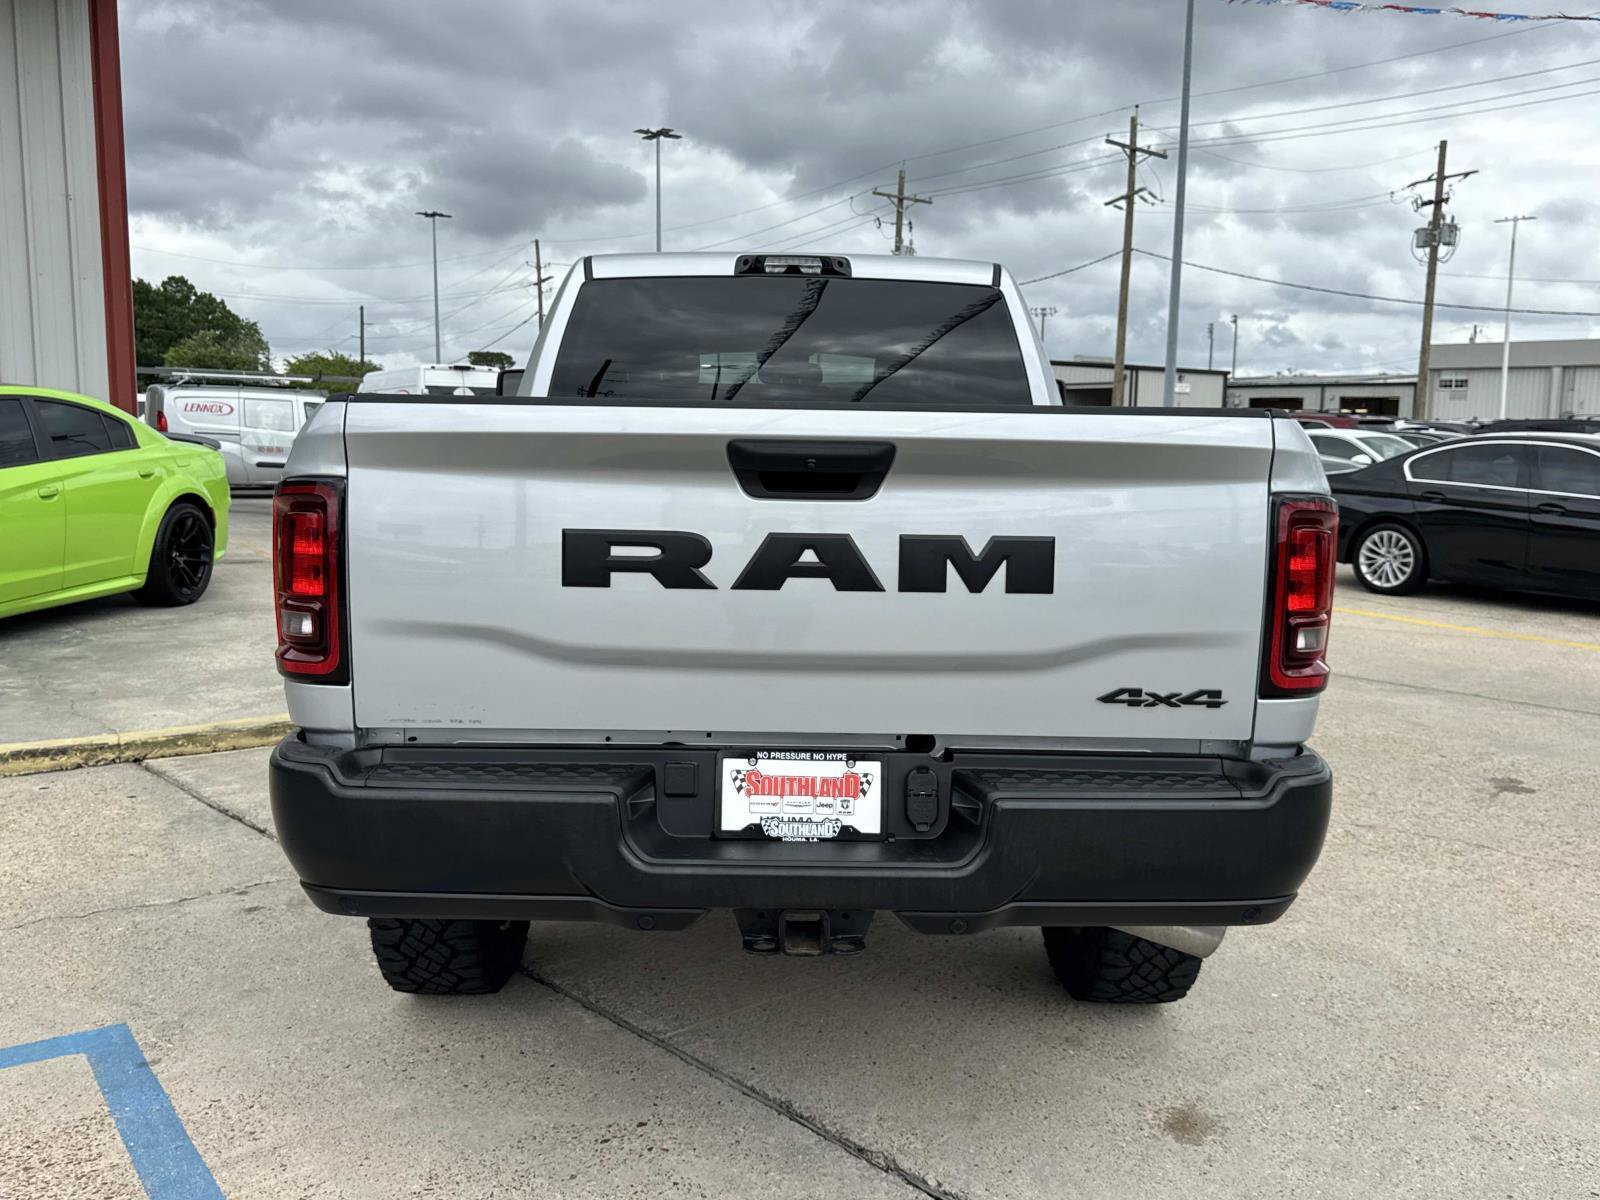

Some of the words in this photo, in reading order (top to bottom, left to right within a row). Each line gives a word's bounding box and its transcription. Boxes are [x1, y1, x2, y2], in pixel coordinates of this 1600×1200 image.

[184, 402, 224, 414] LENNOX
[562, 528, 1056, 594] RAM
[1096, 688, 1229, 708] 4x4
[771, 752, 811, 760] PRESSURE
[826, 753, 847, 761] HYPE
[745, 769, 860, 799] SOUTHLAND
[816, 801, 834, 809] Jeep
[770, 820, 834, 838] SOUTHLAND
